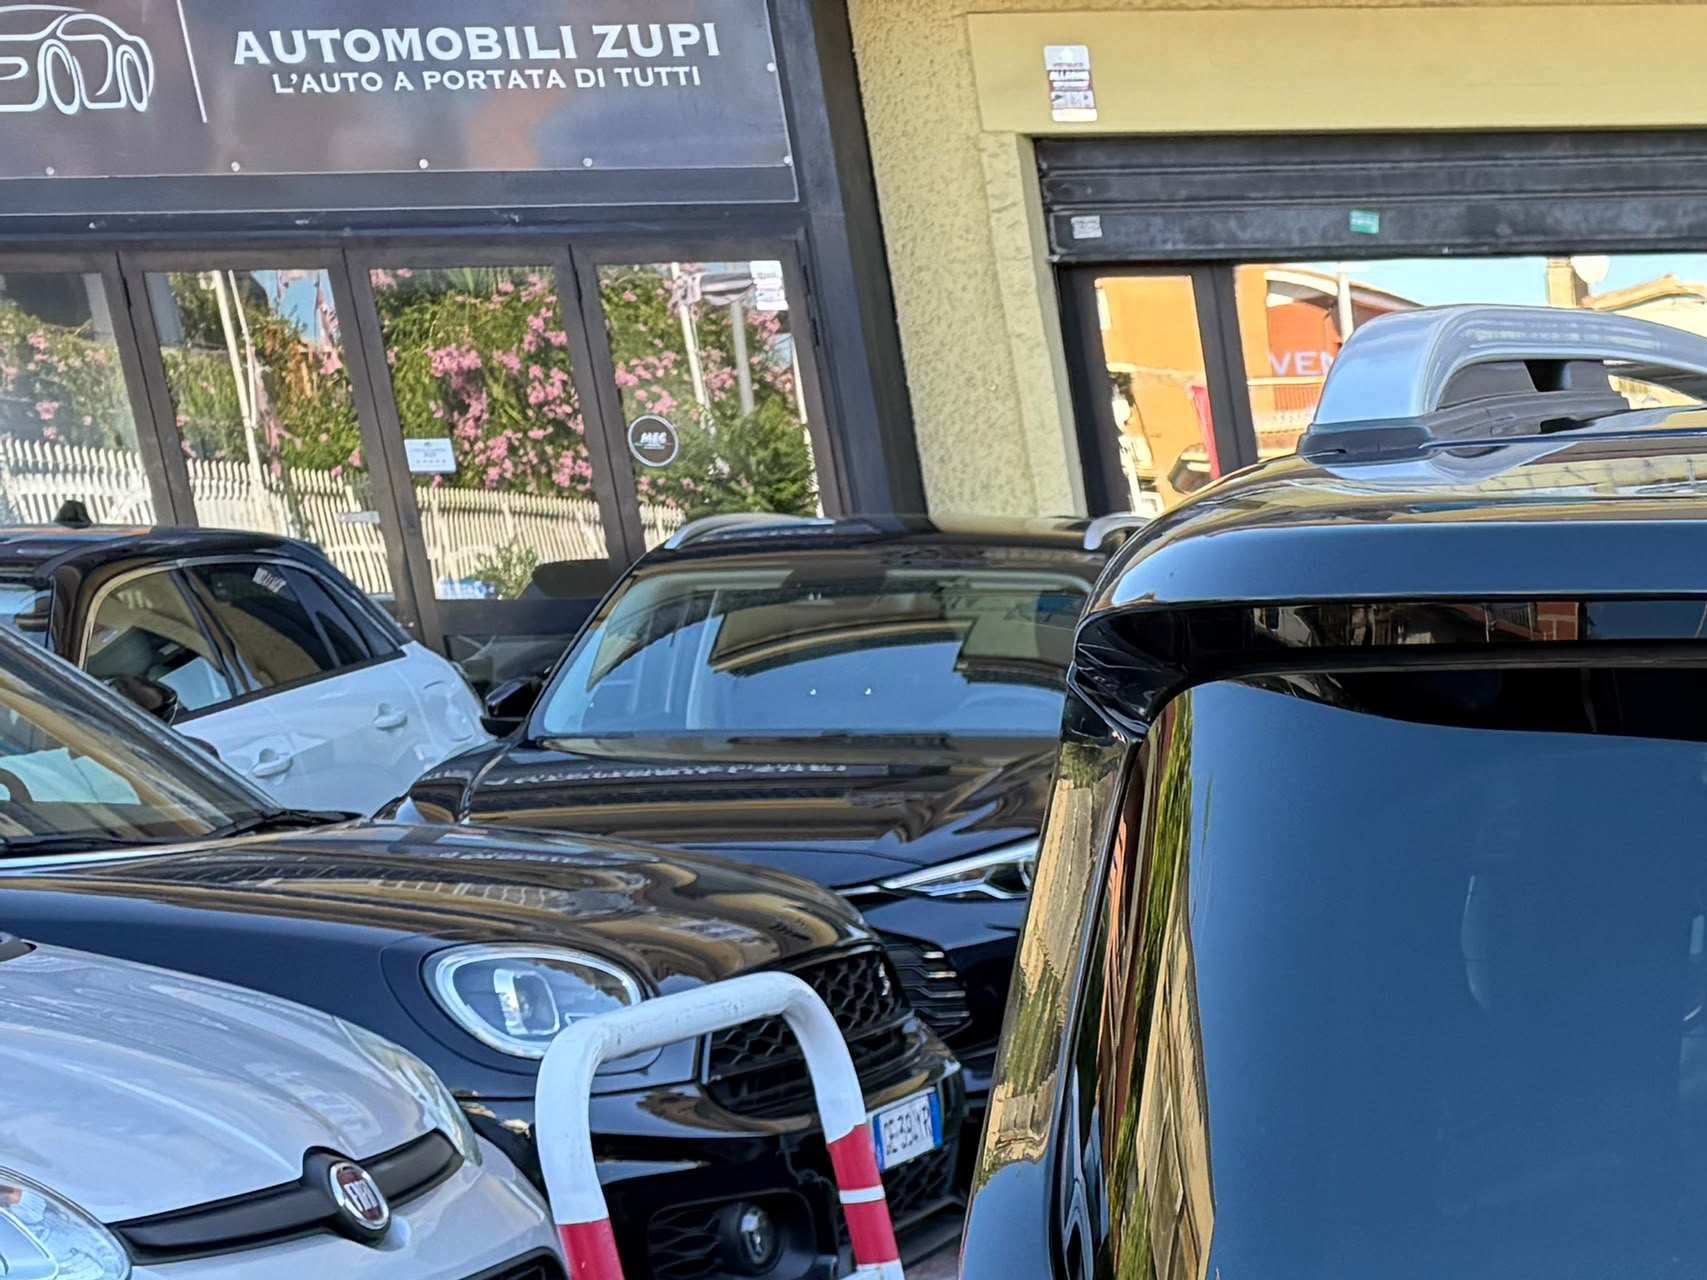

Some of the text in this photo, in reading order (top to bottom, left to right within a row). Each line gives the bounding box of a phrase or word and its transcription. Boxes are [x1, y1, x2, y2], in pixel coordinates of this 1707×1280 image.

[234, 22, 720, 66] AUTOMOBILI ZUPI
[272, 65, 701, 95] L'AUTO A PORTATA DI TUTTI
